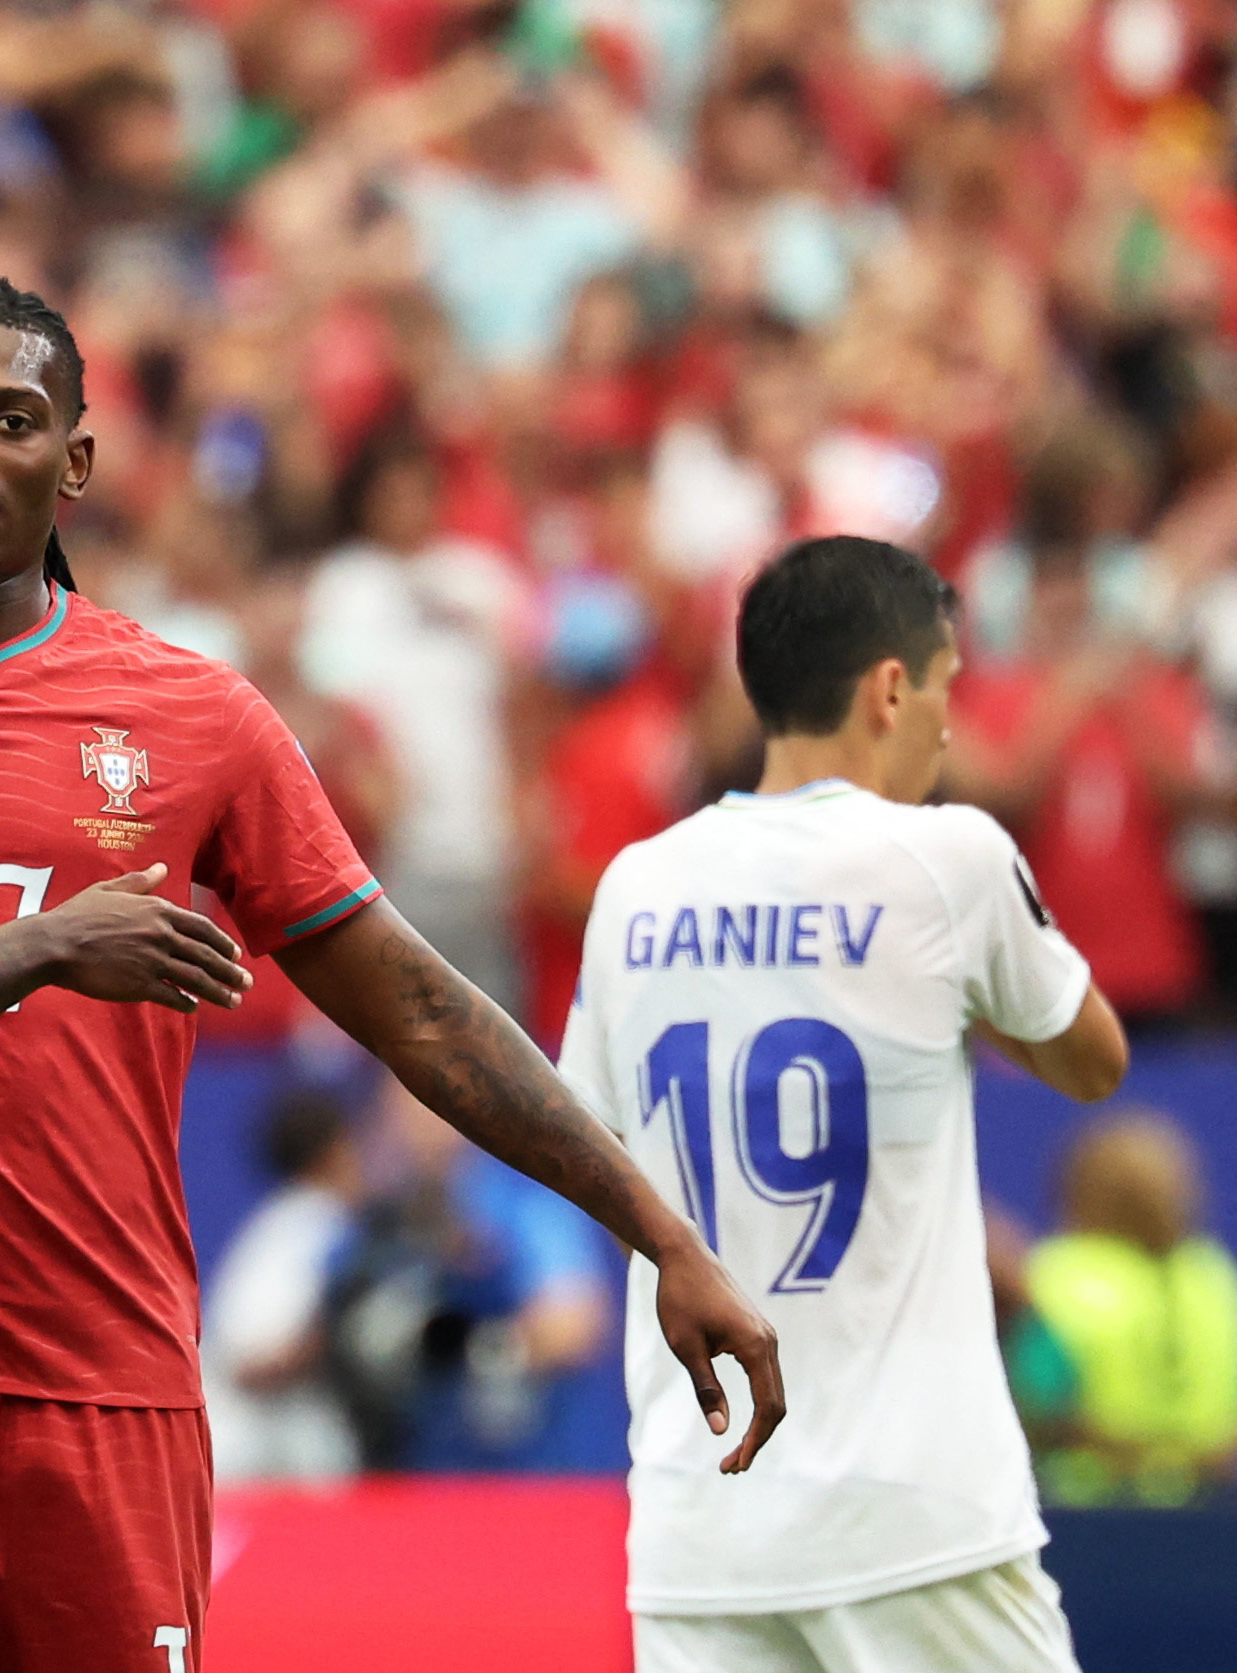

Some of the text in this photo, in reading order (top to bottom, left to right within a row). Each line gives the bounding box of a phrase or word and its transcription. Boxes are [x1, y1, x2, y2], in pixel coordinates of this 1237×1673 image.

[98, 838, 135, 851] HOUSTON
[624, 904, 884, 970] GANIEV
[636, 1016, 874, 1294] 19
